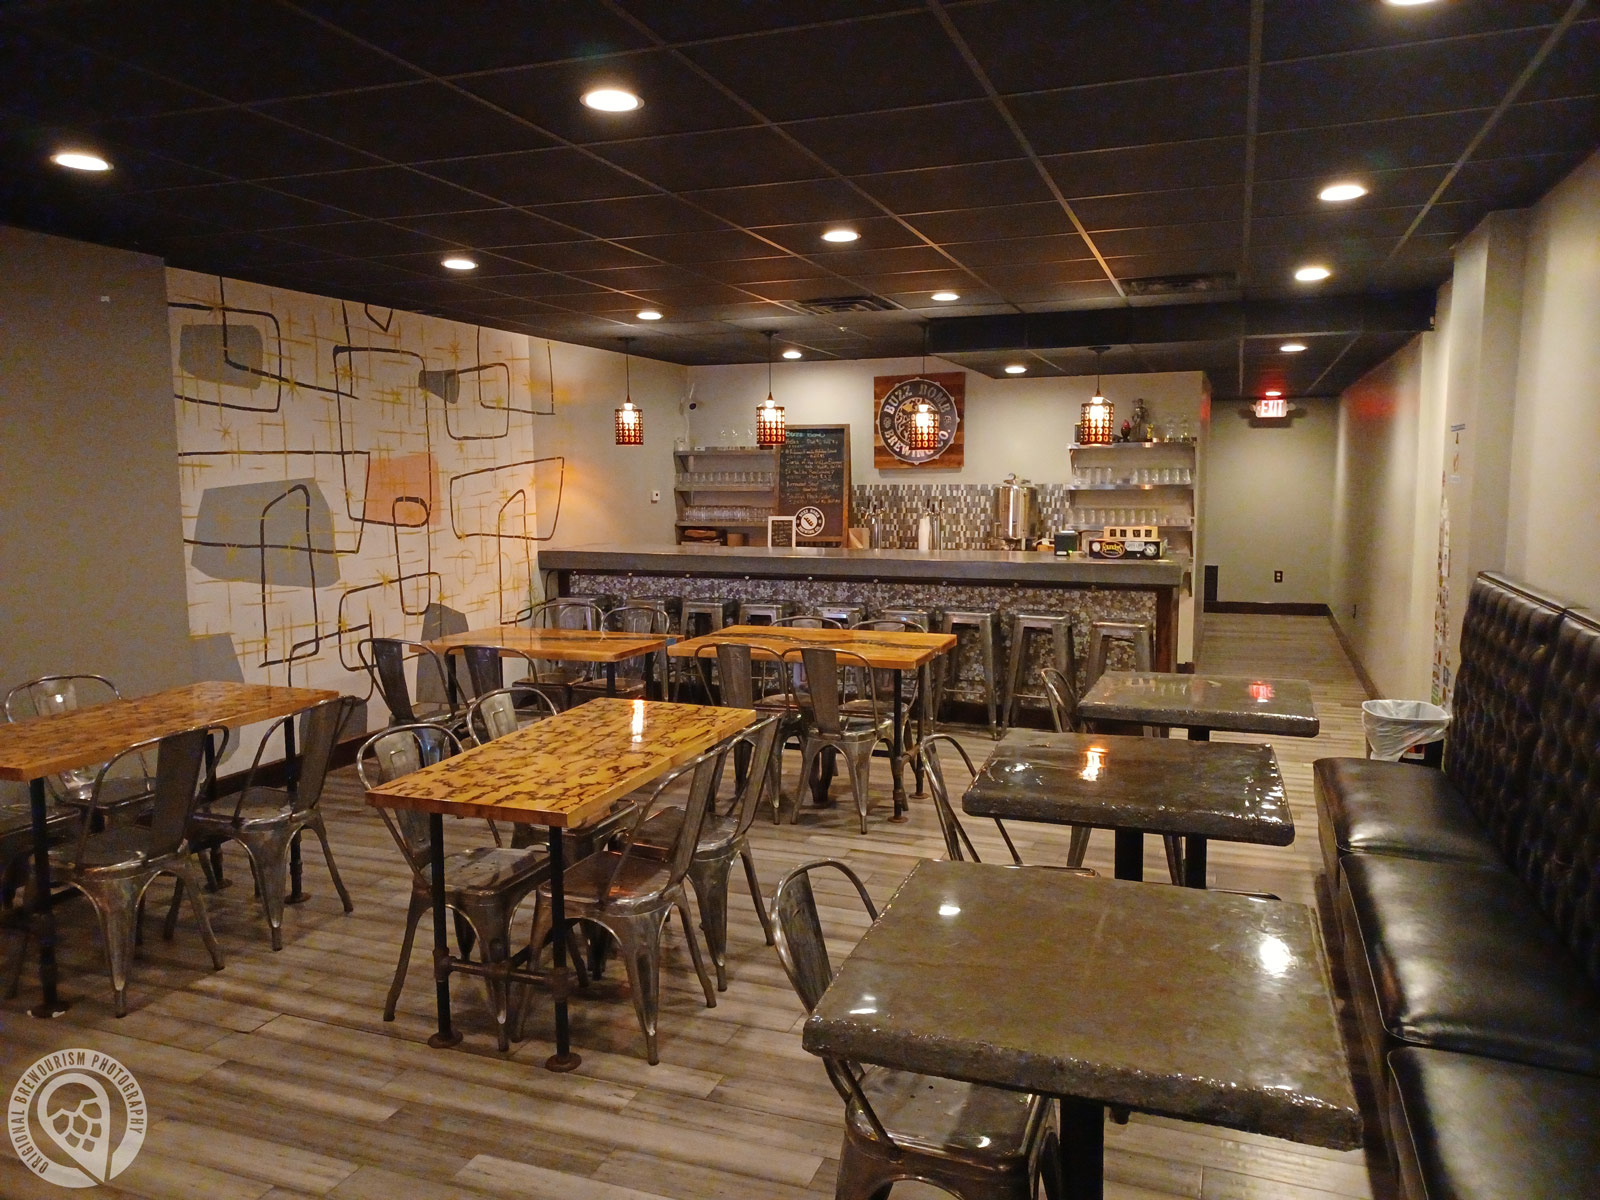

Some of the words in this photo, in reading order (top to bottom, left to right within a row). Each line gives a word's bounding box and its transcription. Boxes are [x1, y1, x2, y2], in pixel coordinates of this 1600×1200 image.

[884, 385, 913, 415] BUZZ
[919, 384, 951, 413] BOMB
[1261, 400, 1284, 416] EXIT
